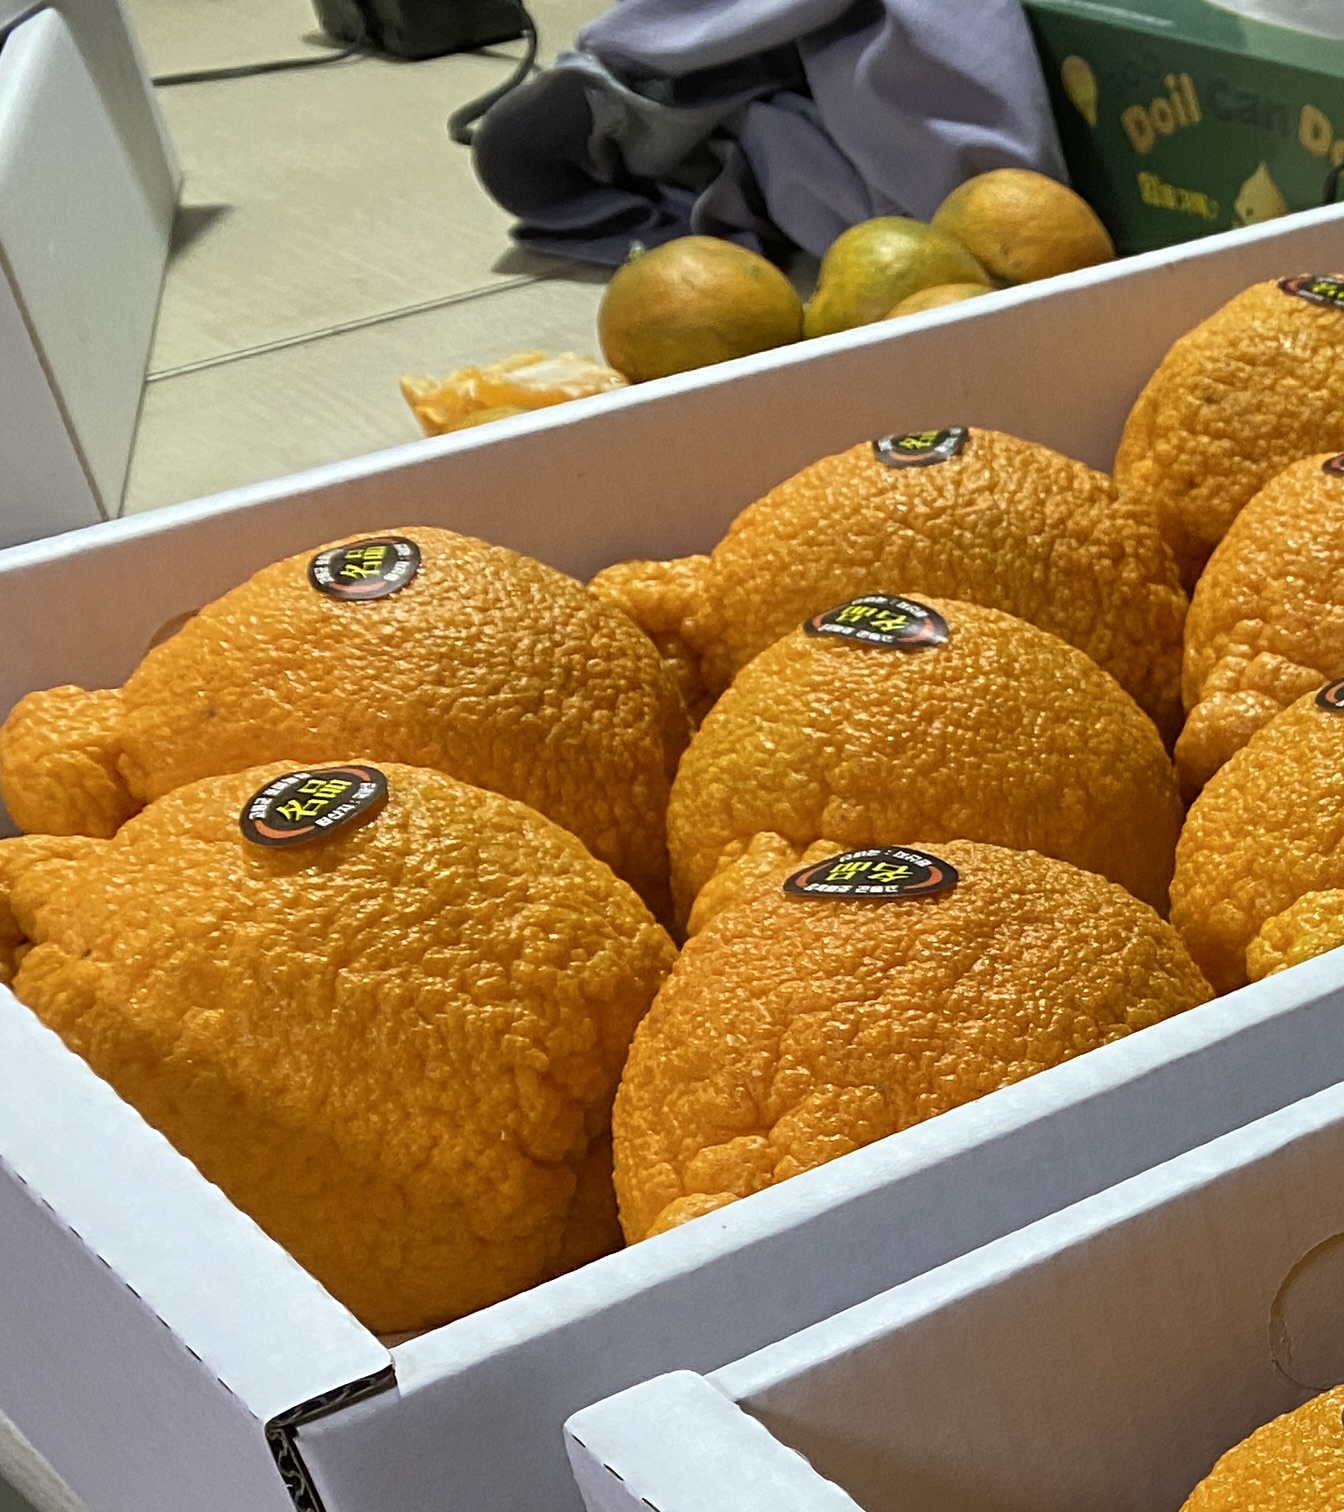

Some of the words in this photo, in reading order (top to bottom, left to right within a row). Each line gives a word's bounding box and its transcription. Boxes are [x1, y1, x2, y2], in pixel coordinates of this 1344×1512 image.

[340, 546, 386, 578] 名品
[276, 779, 352, 821] 名品
[826, 862, 914, 882] 名品
